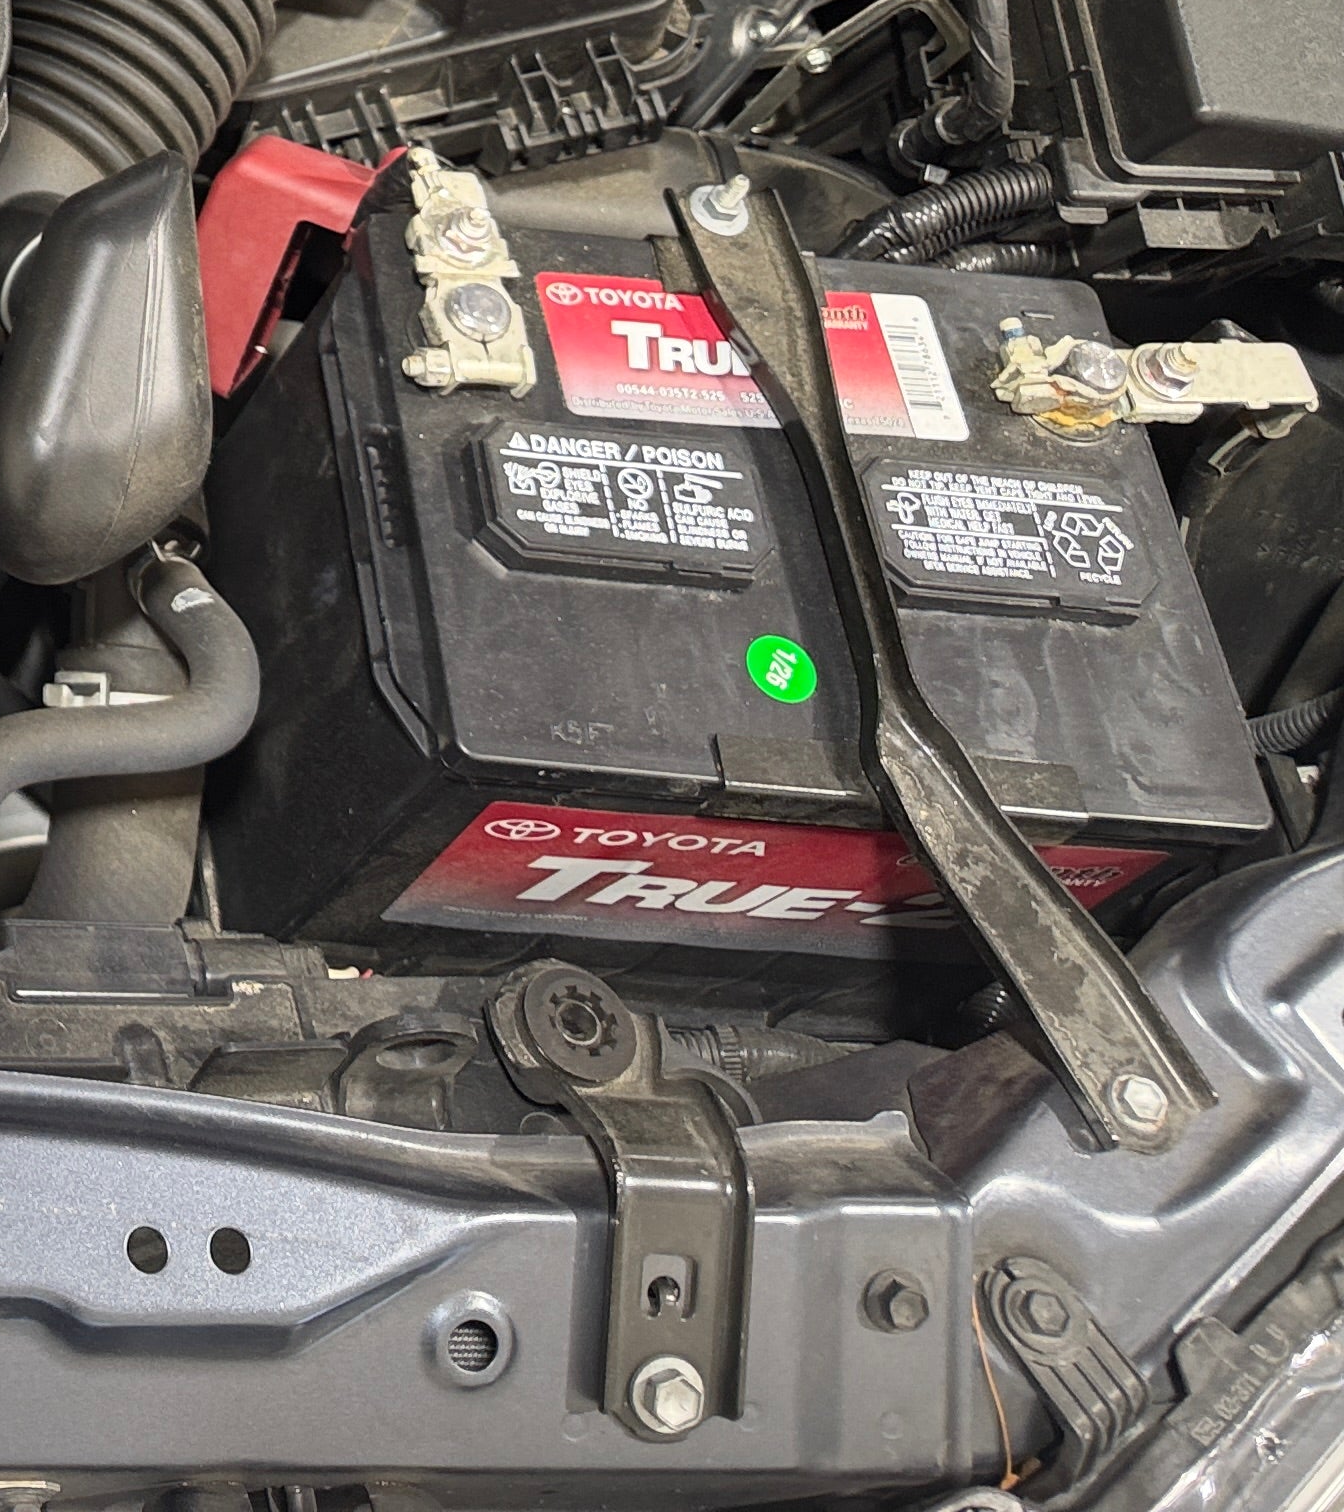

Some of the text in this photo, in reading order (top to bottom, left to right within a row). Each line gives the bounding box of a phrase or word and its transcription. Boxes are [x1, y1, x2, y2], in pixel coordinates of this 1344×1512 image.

[583, 286, 685, 312] TOYOTA
[821, 305, 867, 321] onth
[529, 434, 622, 460] DANGER
[641, 445, 725, 471] POISON
[561, 465, 602, 483] SHIELD
[908, 469, 933, 481] KEEP
[564, 477, 595, 492] EYES
[539, 486, 602, 506] EXPLOSIVE
[627, 497, 649, 512] NO
[672, 501, 755, 523] SULFURIC ACID
[765, 648, 799, 691] 1/26
[572, 827, 768, 857] TOYOTA
